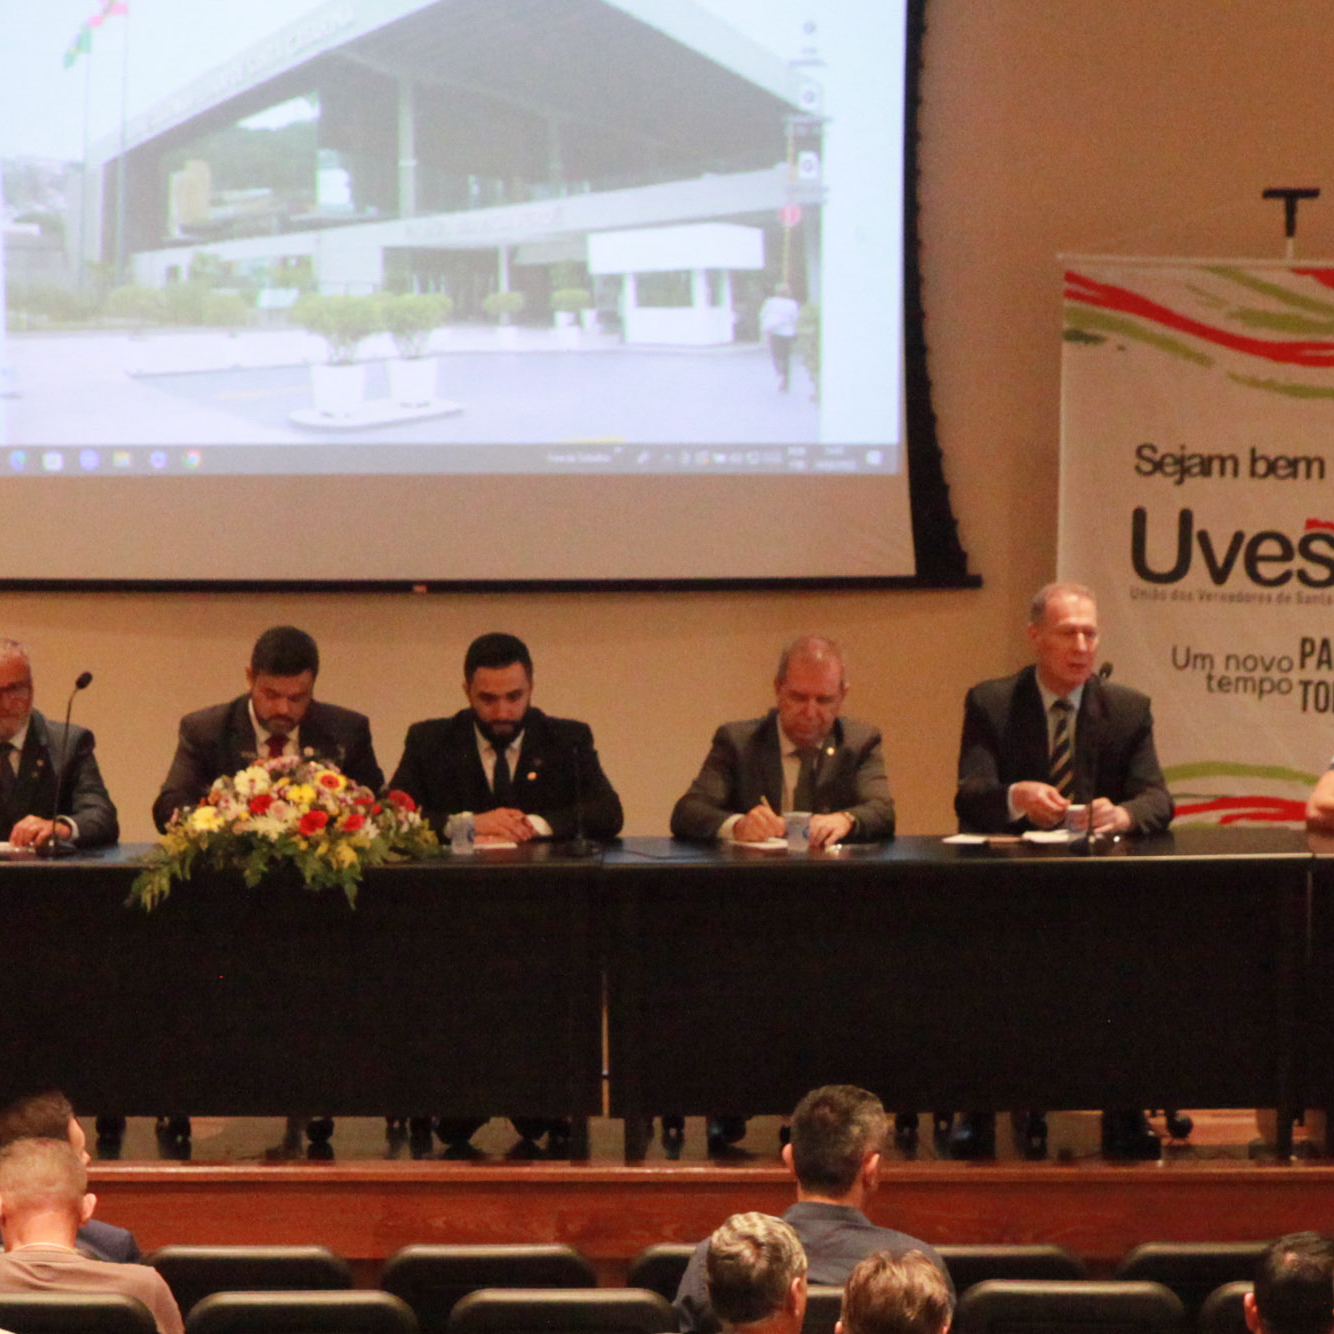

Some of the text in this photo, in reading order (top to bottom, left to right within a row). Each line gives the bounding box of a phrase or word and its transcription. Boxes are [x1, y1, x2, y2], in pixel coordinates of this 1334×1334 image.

[1134, 443, 1239, 486] Sejam
[1250, 447, 1325, 480] bem
[1171, 645, 1294, 673] Um novo
[1206, 672, 1293, 700] tempo
